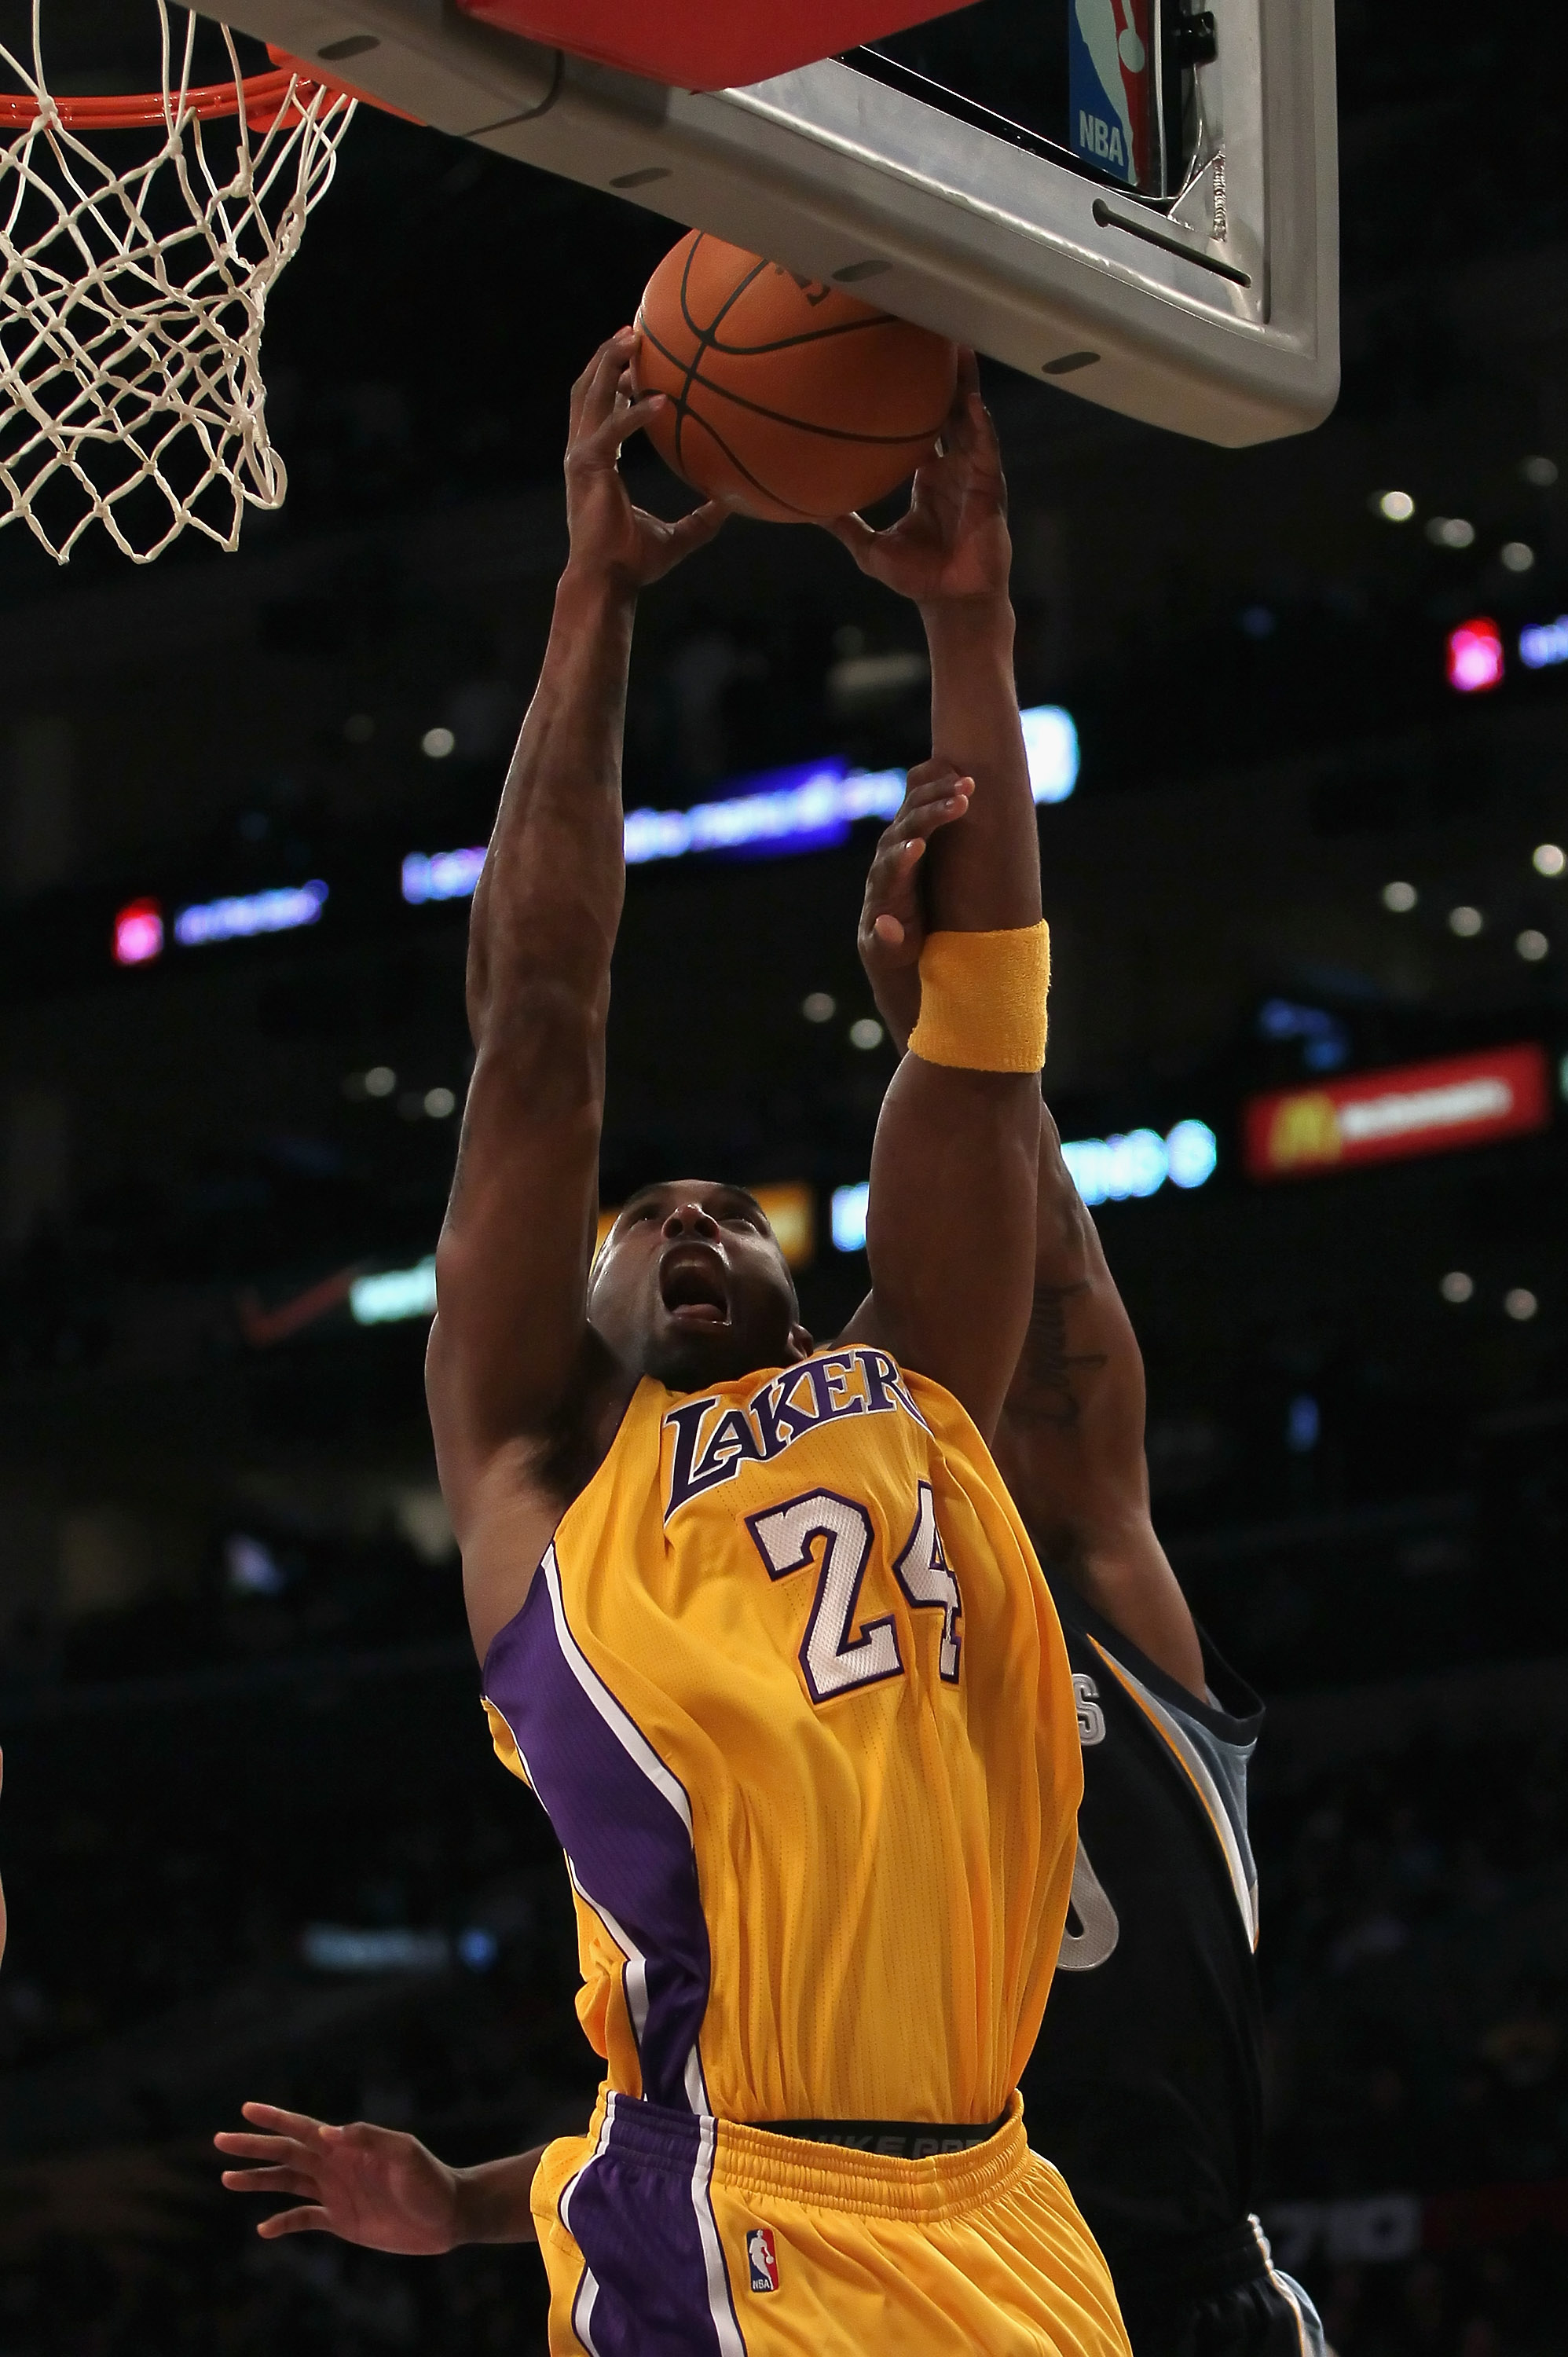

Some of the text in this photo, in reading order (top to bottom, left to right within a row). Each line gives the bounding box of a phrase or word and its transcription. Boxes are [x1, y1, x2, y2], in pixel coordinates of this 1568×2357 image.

[1079, 109, 1124, 167] NBA
[661, 1347, 935, 1528] LAKER
[745, 1479, 962, 1704] 24
[753, 2279, 771, 2289] NBA
